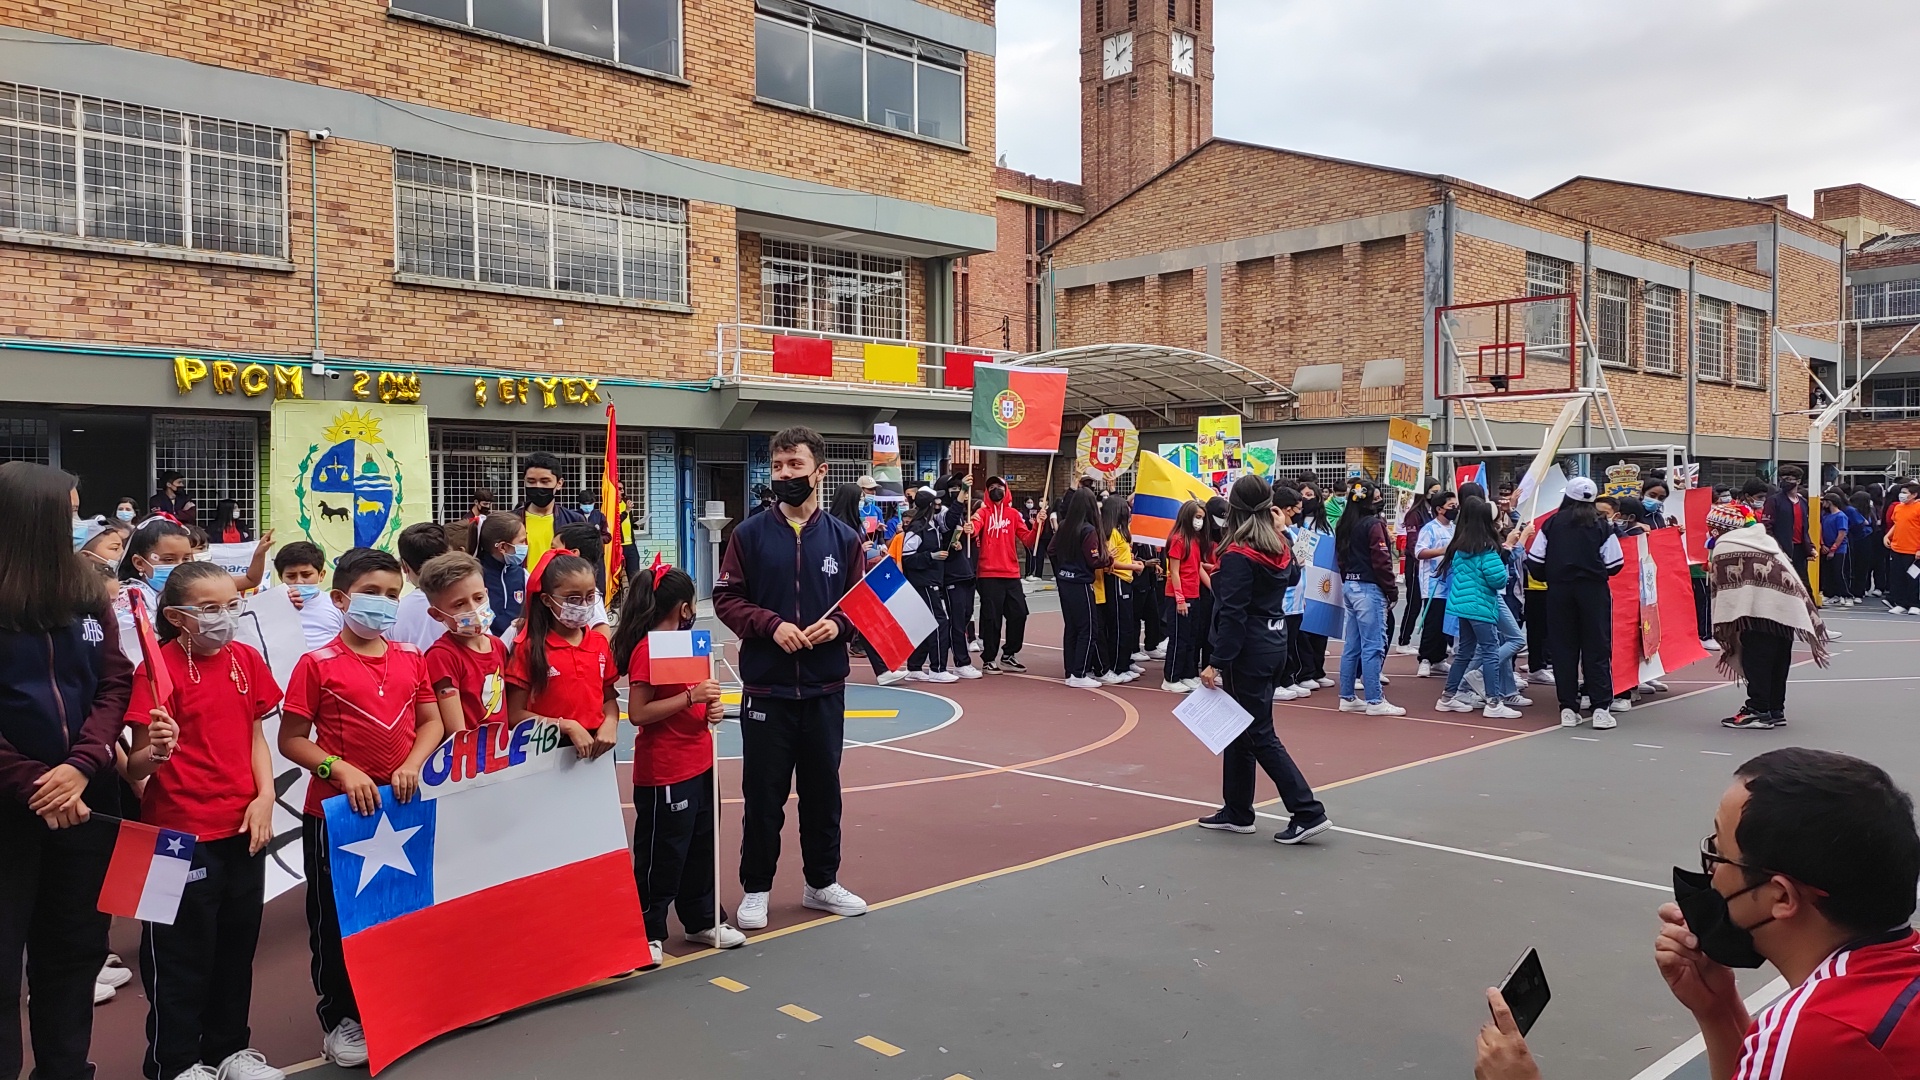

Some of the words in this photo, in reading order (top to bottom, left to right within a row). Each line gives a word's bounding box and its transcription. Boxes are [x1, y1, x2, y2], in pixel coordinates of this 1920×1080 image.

[174, 356, 304, 401] PROM
[423, 719, 536, 786] CHILE
[530, 721, 559, 756] 4B
